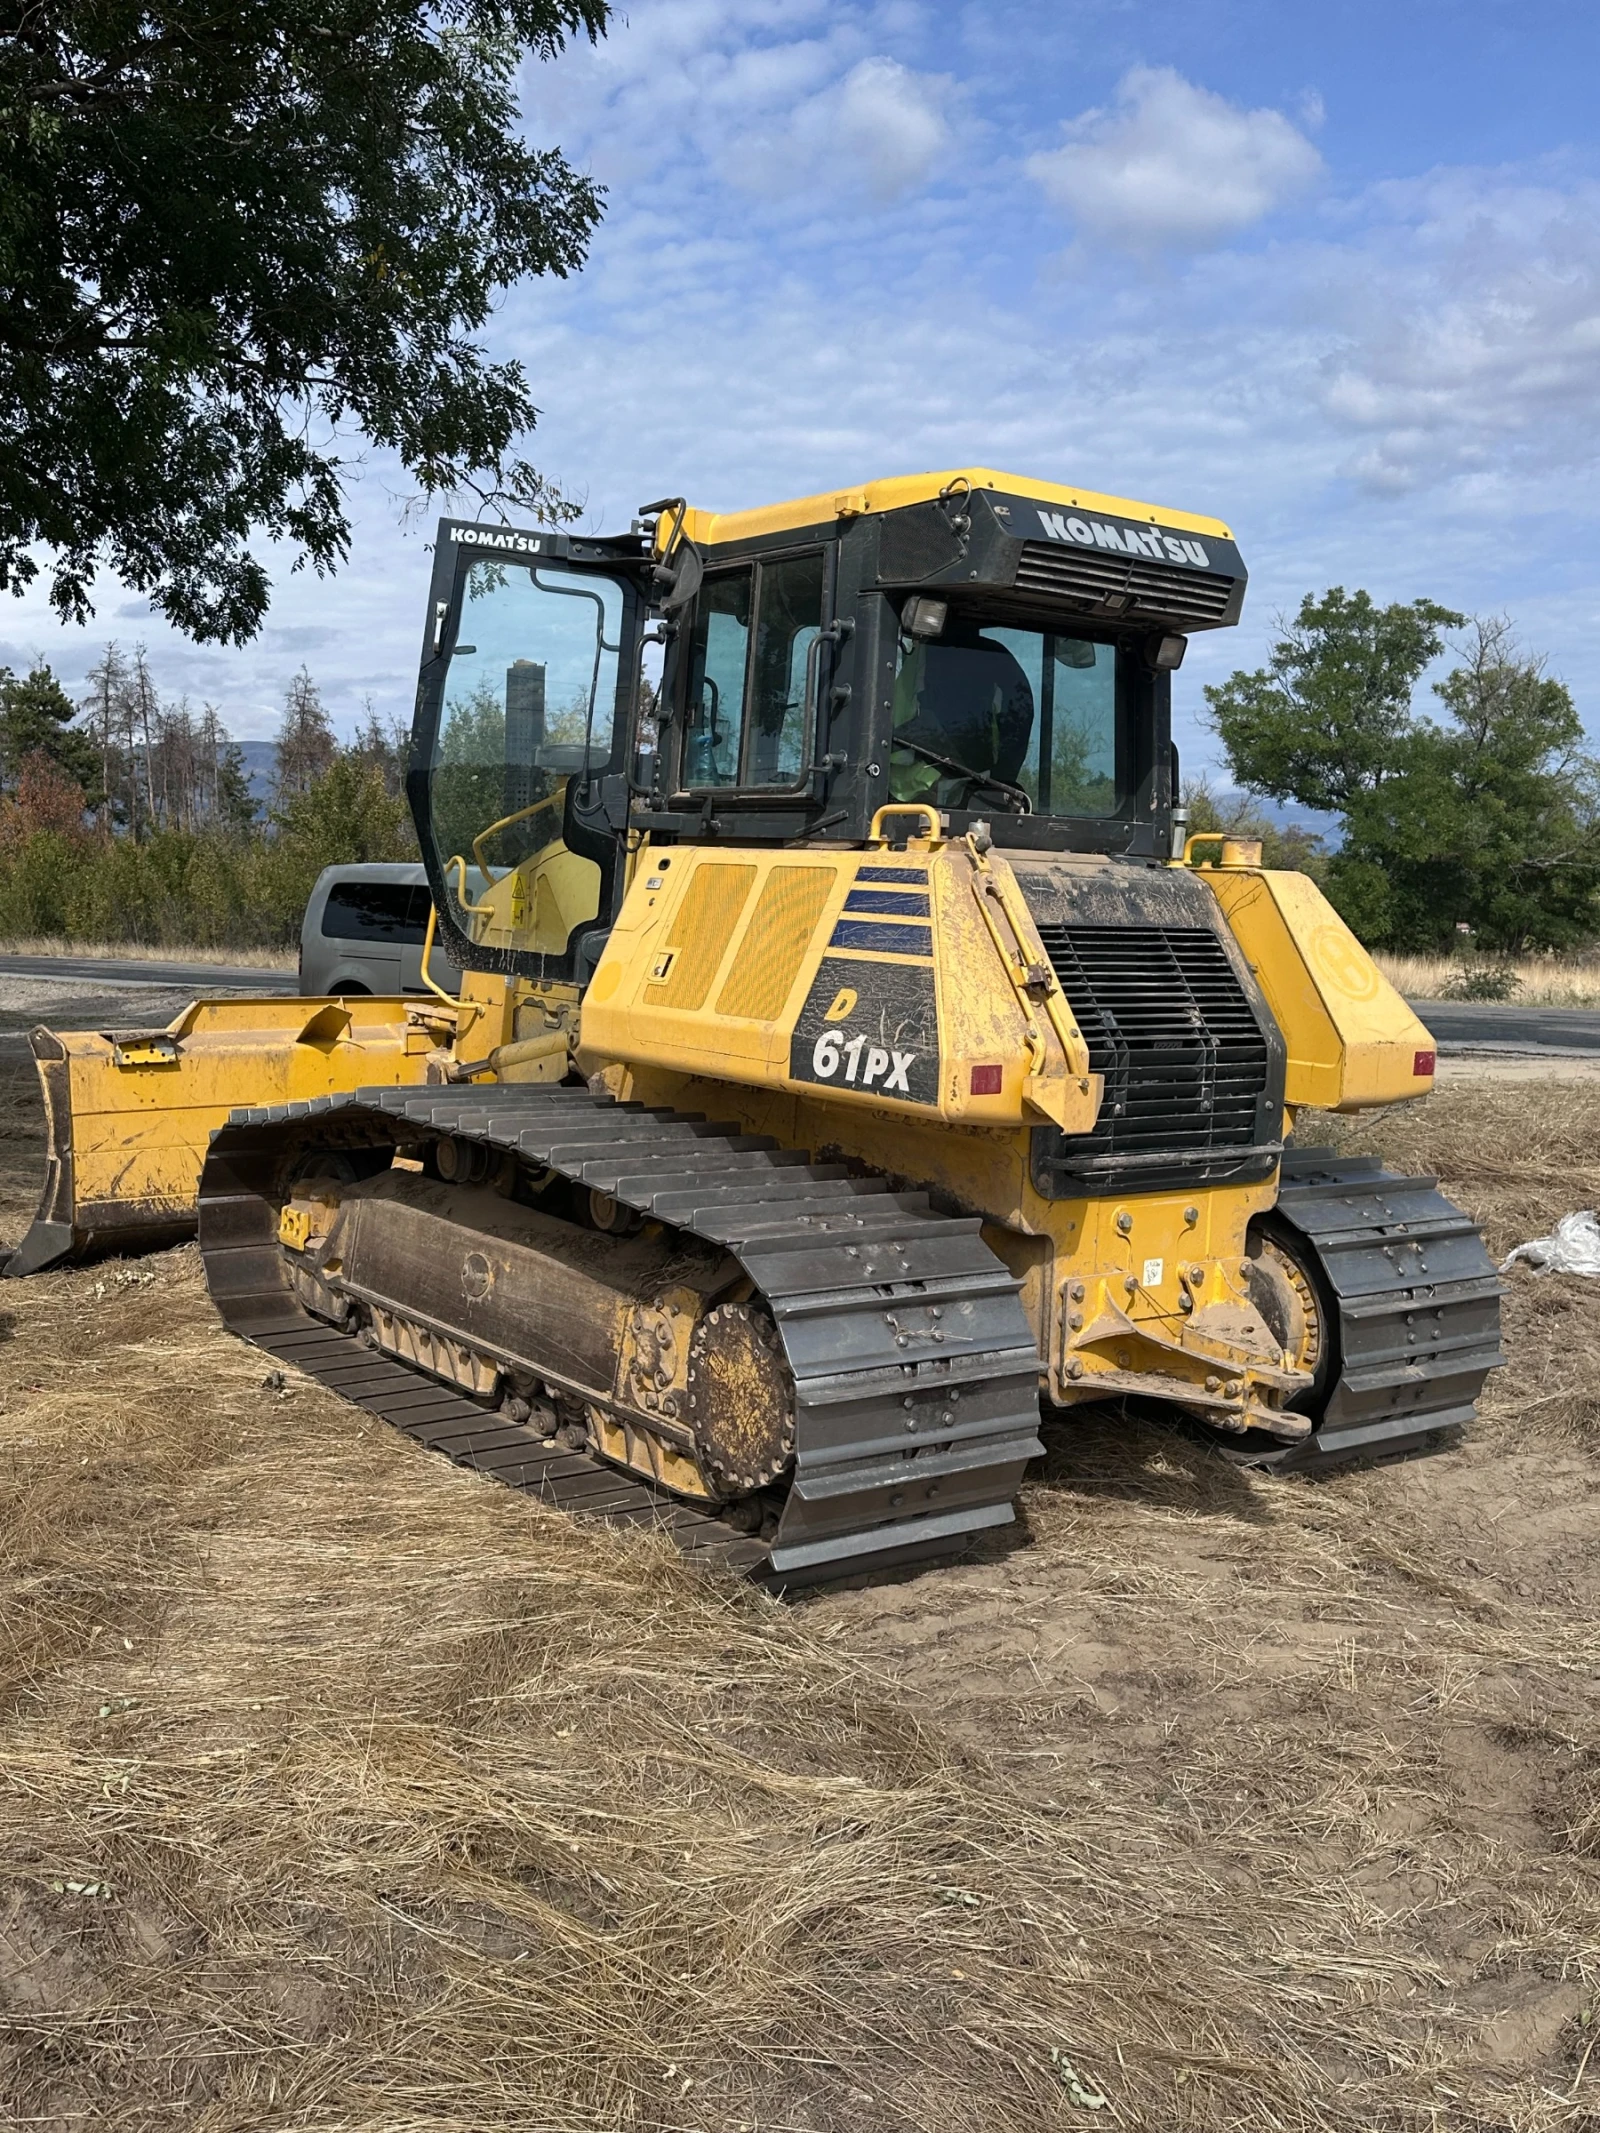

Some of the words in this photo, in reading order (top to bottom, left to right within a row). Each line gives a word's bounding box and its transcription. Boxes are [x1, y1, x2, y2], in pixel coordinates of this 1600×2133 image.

[450, 527, 541, 553] KOMATSU
[1036, 510, 1210, 567] KOMATSU
[824, 988, 858, 1021] D
[813, 1030, 916, 1092] 61PX
